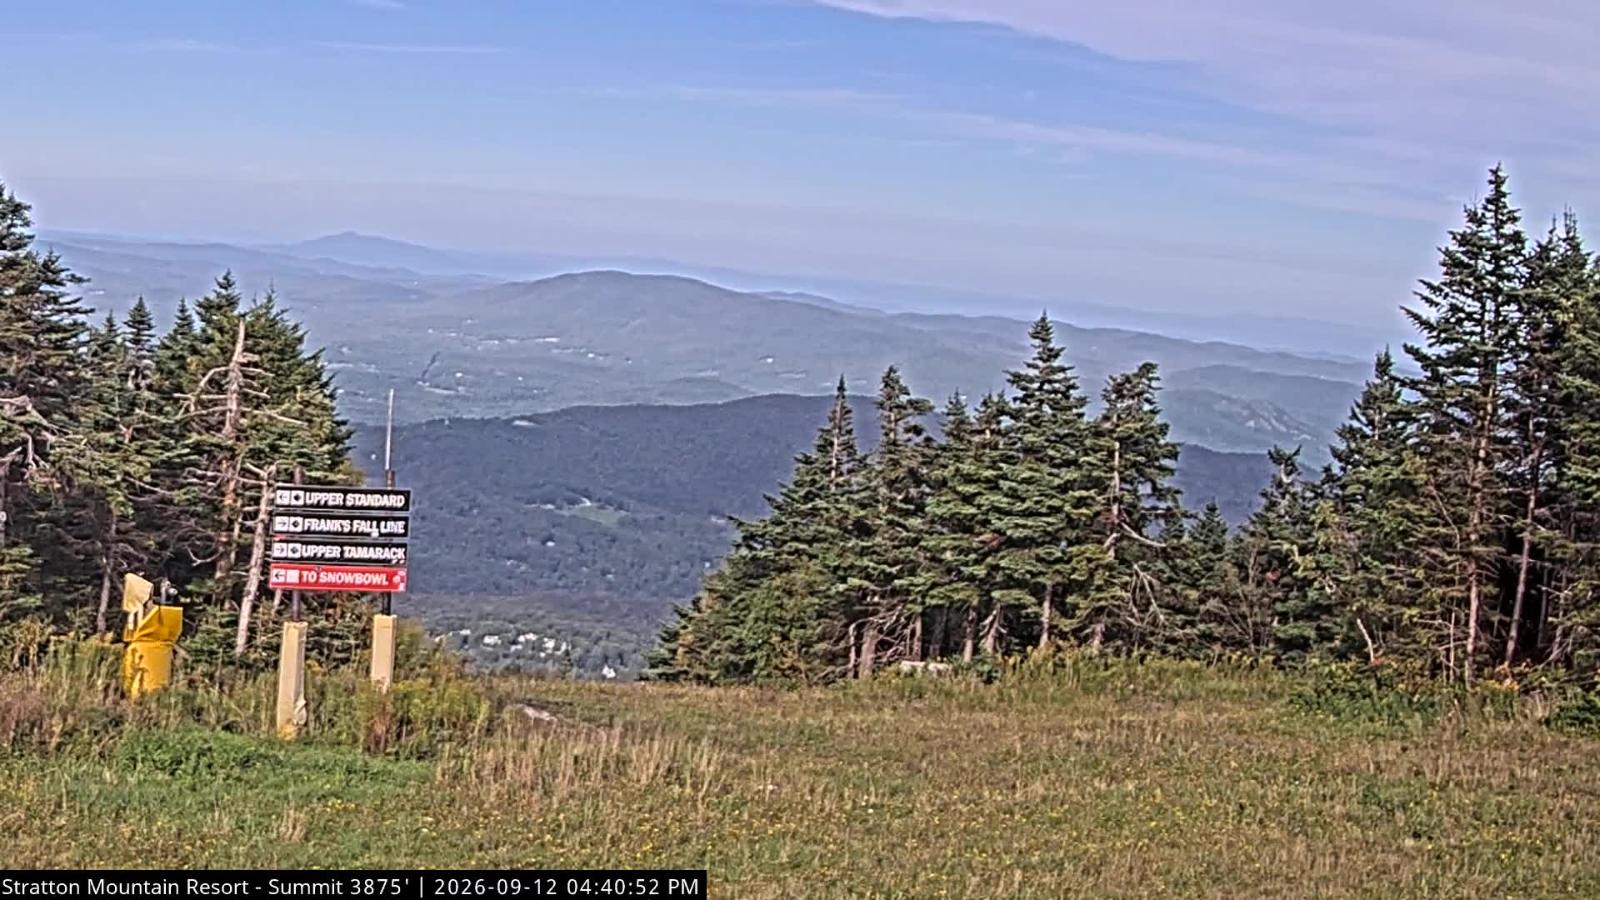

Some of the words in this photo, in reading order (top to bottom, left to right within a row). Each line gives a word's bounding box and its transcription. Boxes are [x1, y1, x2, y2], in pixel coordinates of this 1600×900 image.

[305, 492, 344, 506] UPPER
[345, 493, 405, 508] STANDARD
[304, 518, 351, 532] FRANK'S
[353, 520, 379, 534] FALL
[380, 520, 405, 534] LINE
[302, 544, 341, 558] UPPER
[343, 545, 406, 560] TAMARACK
[302, 570, 318, 583] TO
[319, 571, 389, 586] SNOWBOWL
